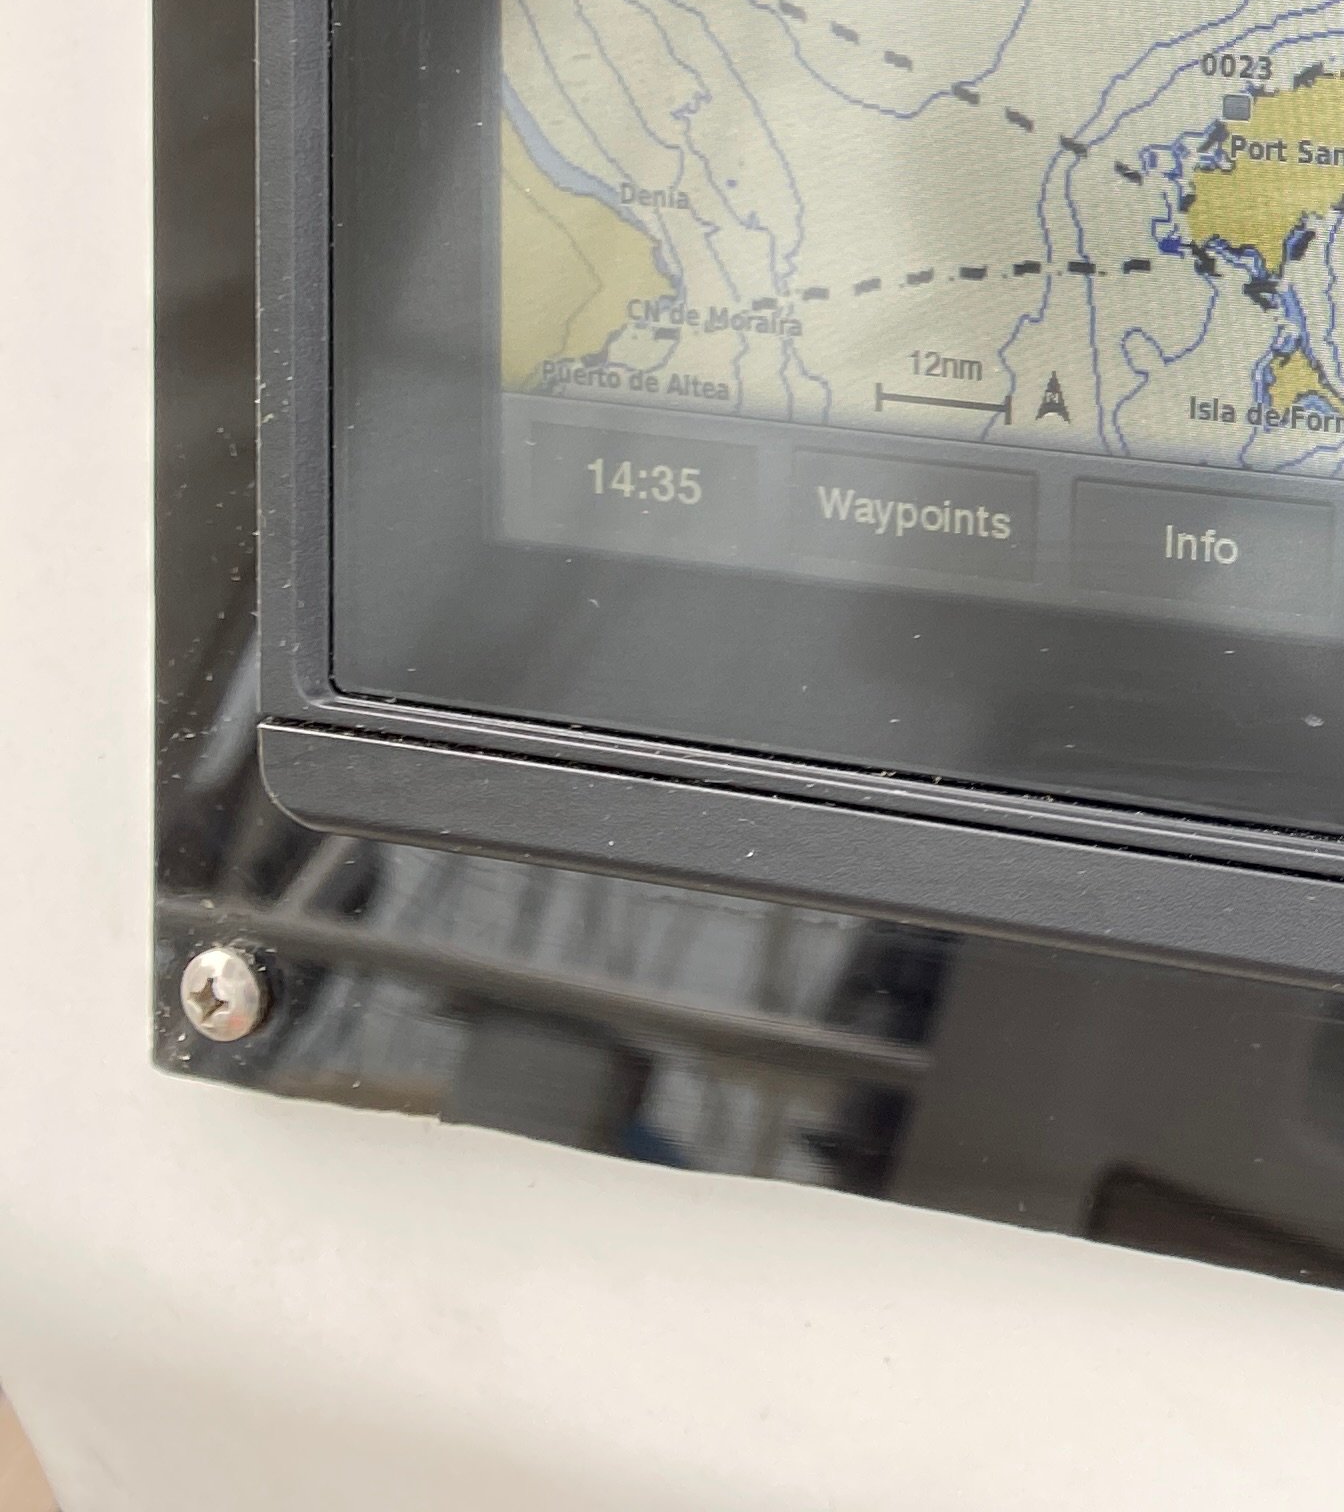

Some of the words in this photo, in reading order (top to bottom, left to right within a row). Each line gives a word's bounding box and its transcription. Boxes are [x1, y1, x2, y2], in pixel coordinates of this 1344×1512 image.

[1200, 53, 1273, 81] 0023
[1230, 134, 1288, 163] Port
[620, 182, 689, 210] Denia
[669, 303, 700, 326] de
[542, 359, 621, 389] Puerto
[629, 369, 659, 393] de
[666, 373, 730, 401] Altea
[908, 349, 983, 383] 12nm
[1188, 395, 1237, 423] Isla
[1246, 402, 1281, 427] de
[587, 457, 702, 505] 14:35
[817, 485, 1013, 541] Waypoints
[1164, 523, 1240, 567] Info
